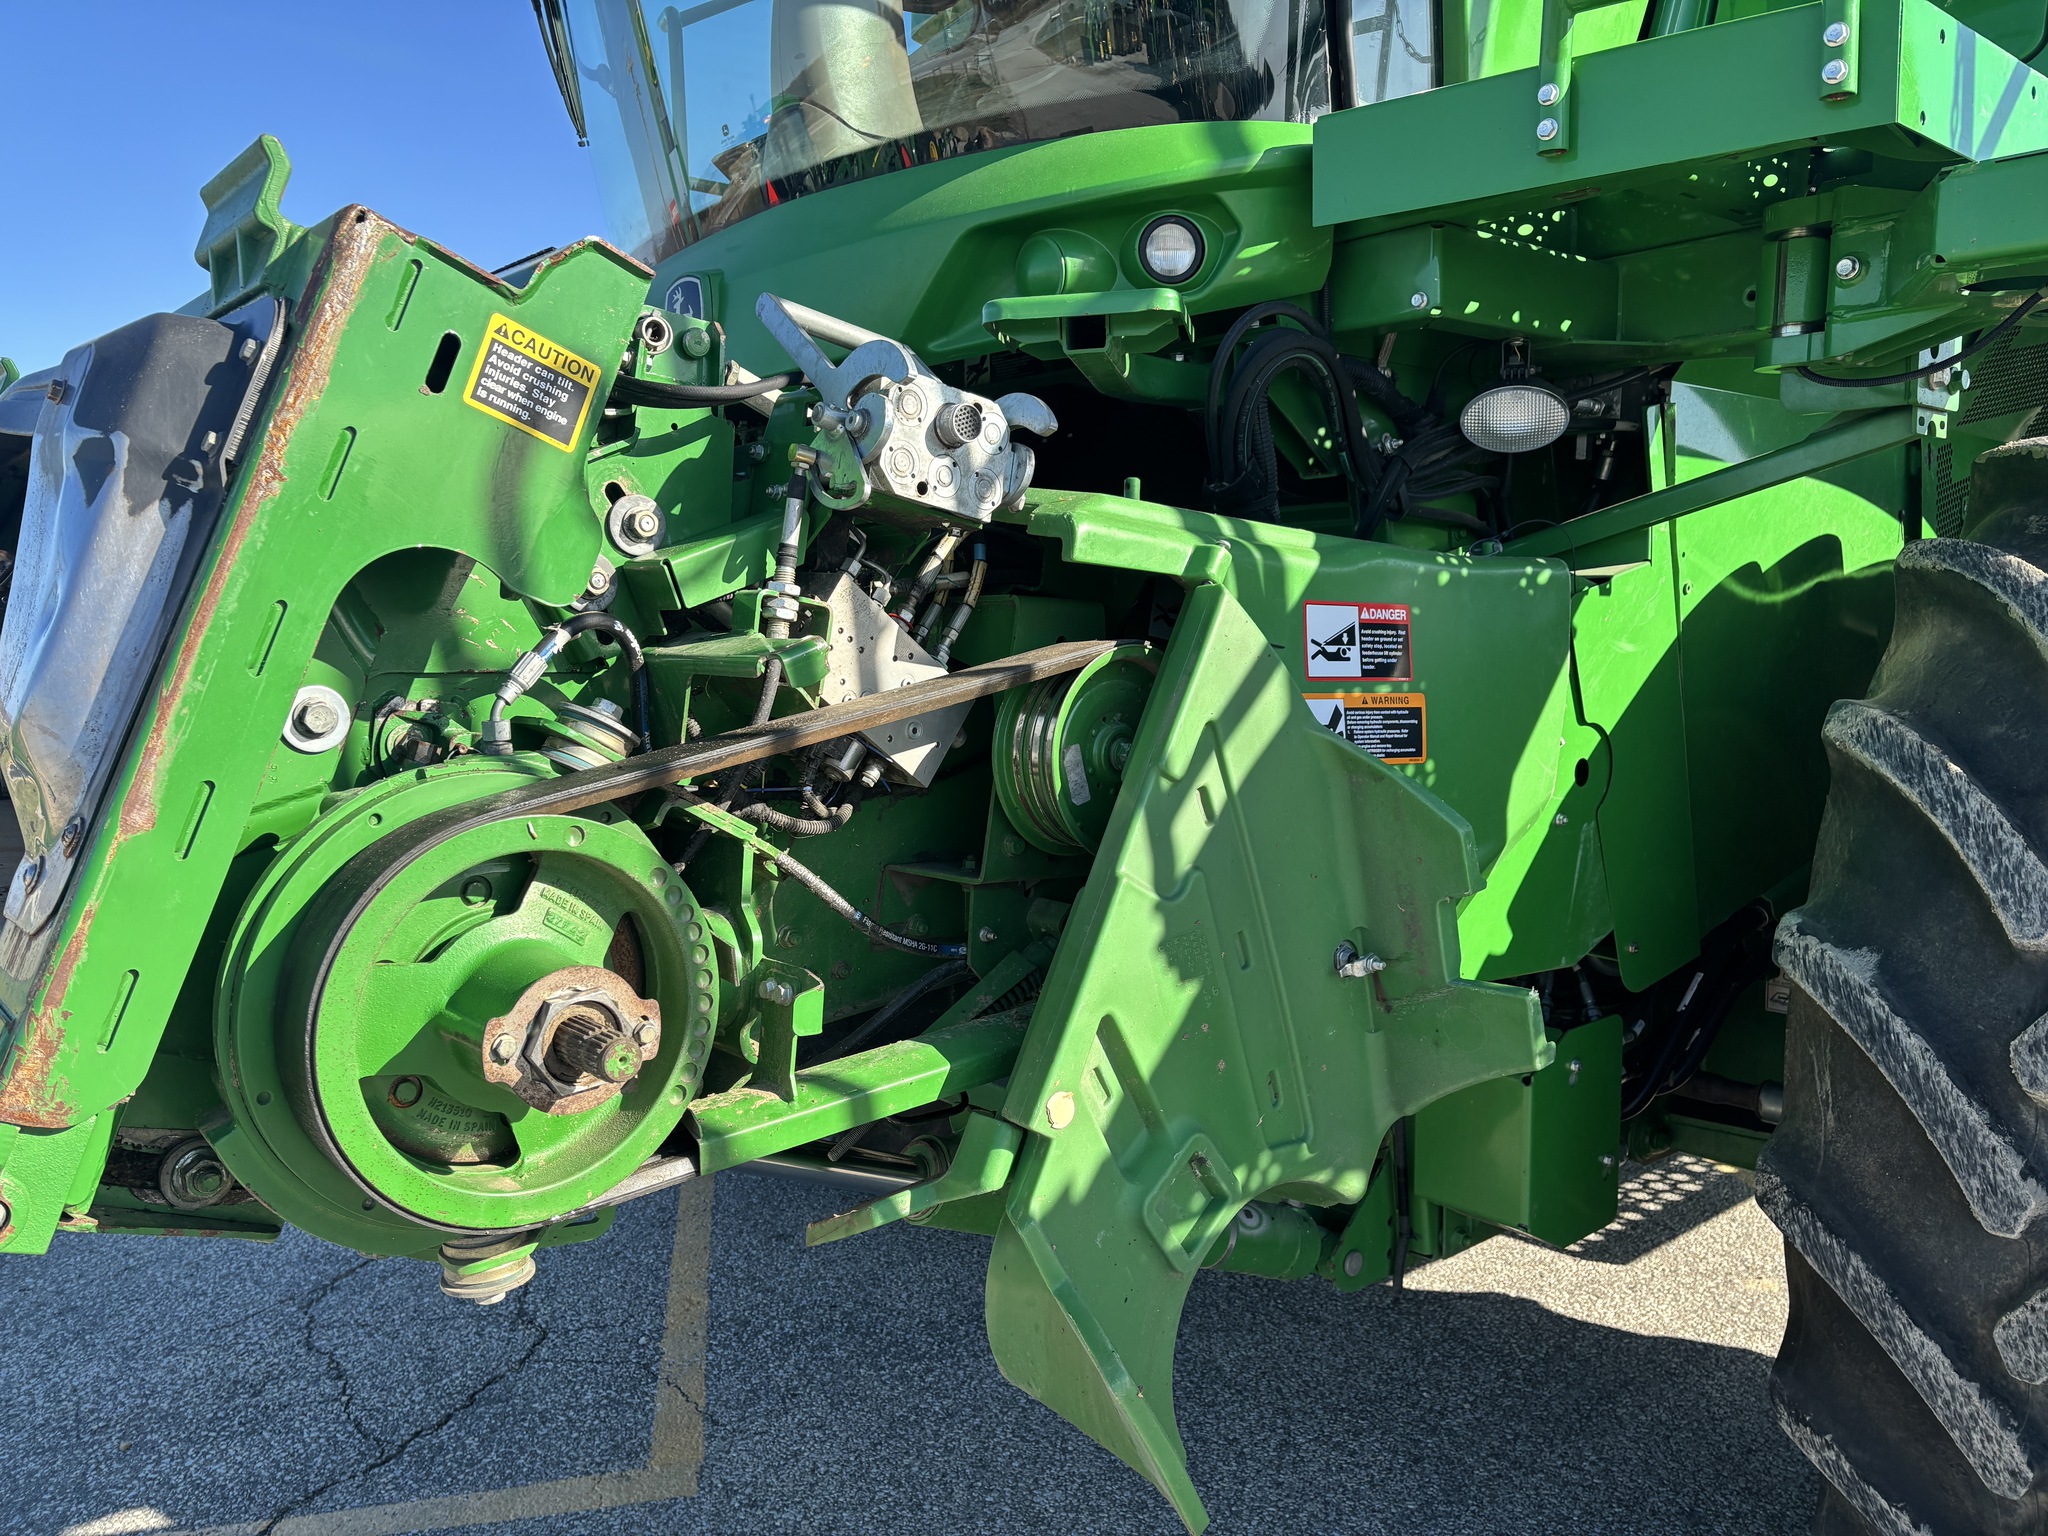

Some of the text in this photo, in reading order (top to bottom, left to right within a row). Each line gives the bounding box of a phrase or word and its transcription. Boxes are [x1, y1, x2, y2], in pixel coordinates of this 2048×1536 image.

[492, 342, 575, 392] Header can tilt.
[511, 329, 596, 384] CAUTION
[484, 365, 557, 408] injuries. Stay
[488, 354, 570, 403] Avoid crushing
[476, 388, 531, 421] is running.
[480, 377, 568, 426] clear when engine
[1370, 609, 1406, 620] DANGER
[1370, 696, 1410, 705] WARNING
[902, 937, 918, 949] MSHA
[416, 1109, 497, 1132] MADE IN SPAIN
